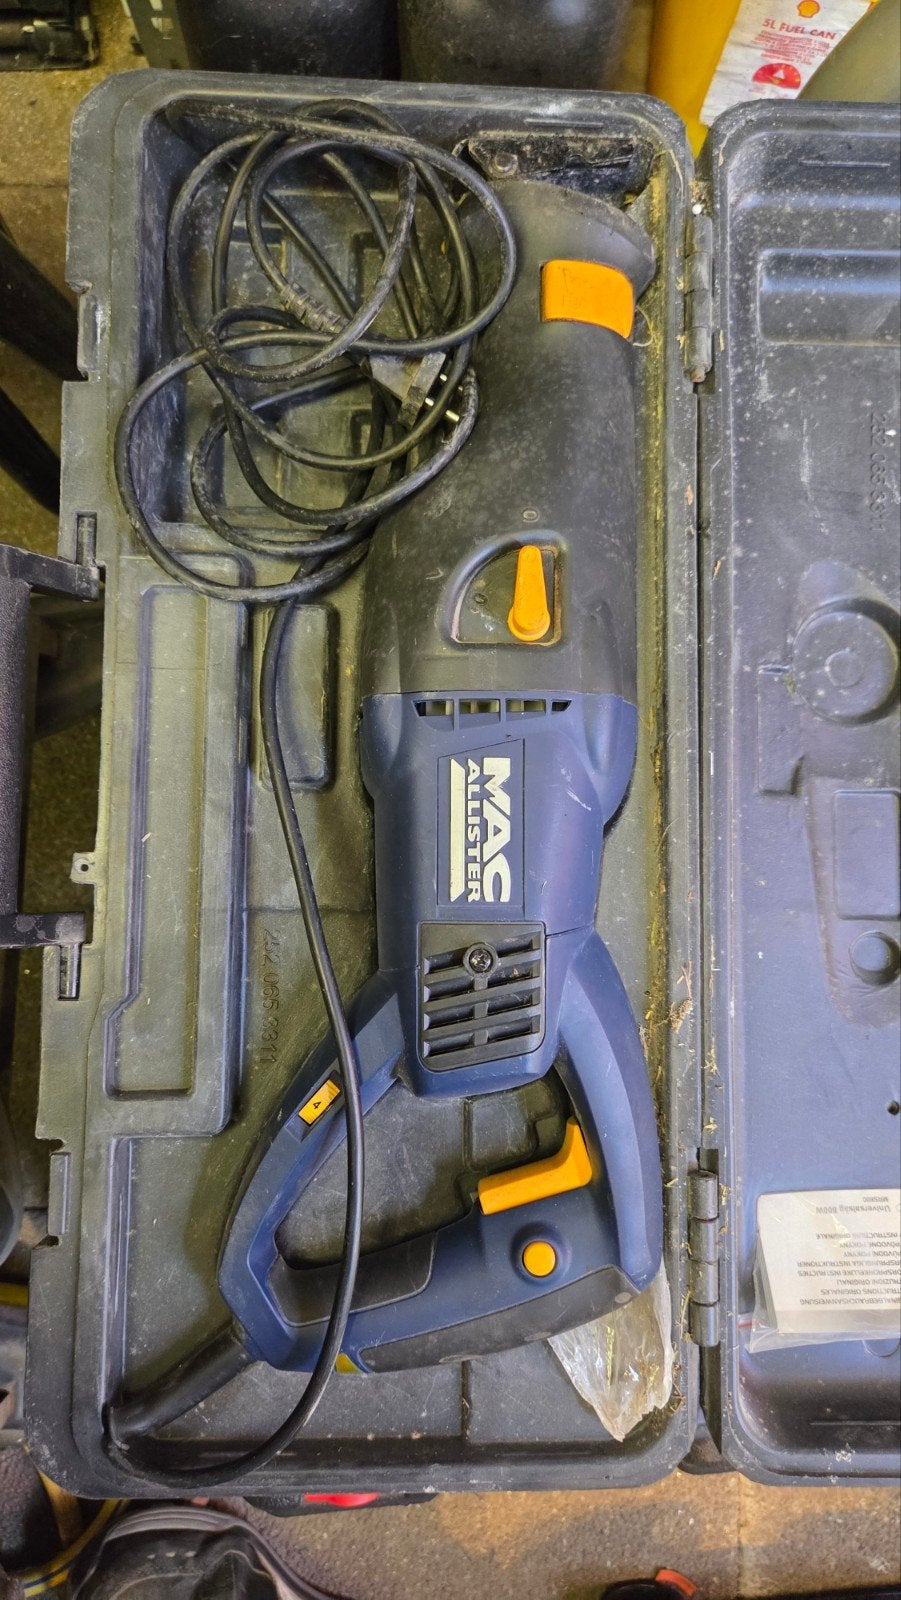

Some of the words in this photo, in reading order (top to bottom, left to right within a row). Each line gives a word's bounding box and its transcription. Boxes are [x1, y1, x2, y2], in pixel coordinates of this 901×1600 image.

[762, 18, 776, 29] 5L
[779, 22, 806, 34] FUEL
[810, 29, 837, 40] CAN
[467, 758, 481, 902] ALLISTER
[483, 757, 511, 902] MAC
[263, 973, 280, 1010] 065
[260, 1017, 279, 1064] 3311
[313, 1101, 322, 1110] 4
